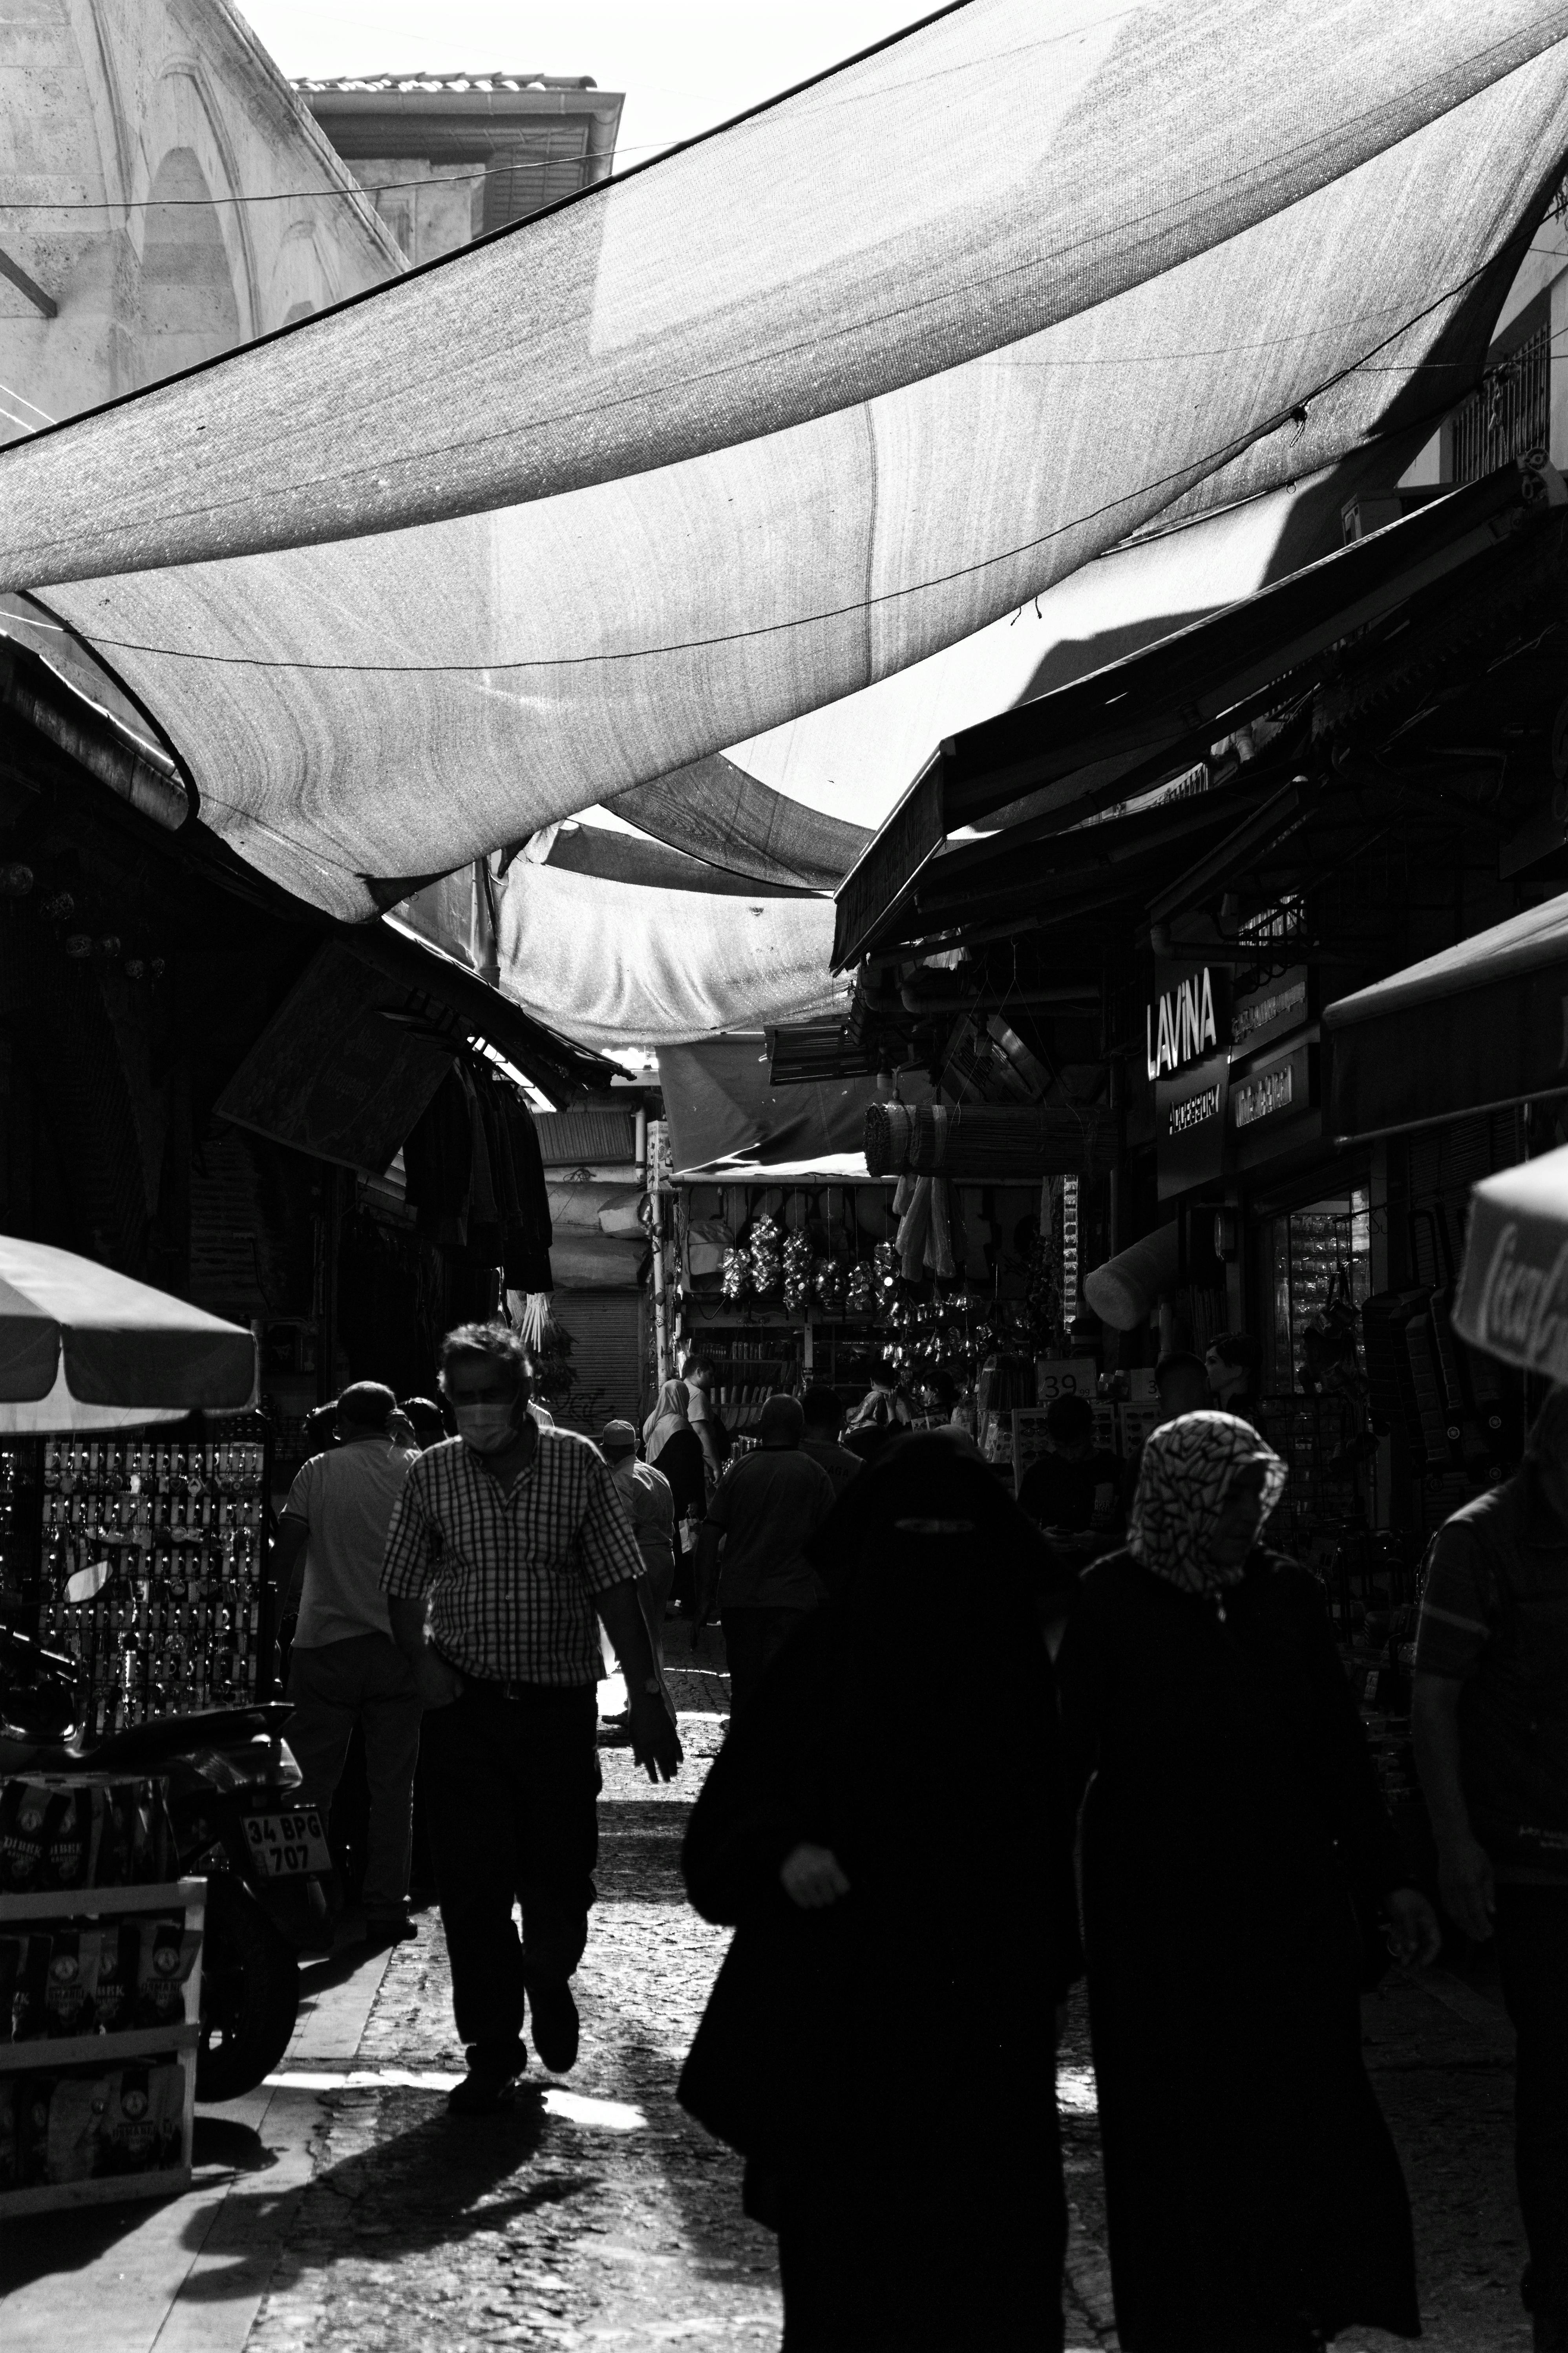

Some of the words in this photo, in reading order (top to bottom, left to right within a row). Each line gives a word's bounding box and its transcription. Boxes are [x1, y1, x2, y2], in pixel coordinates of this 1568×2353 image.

[1168, 1083, 1220, 1135] ACCESSORY
[824, 1465, 849, 1478] AGA
[248, 1819, 276, 1844] 34
[280, 1815, 321, 1841] BPG
[269, 1845, 308, 1873] 707
